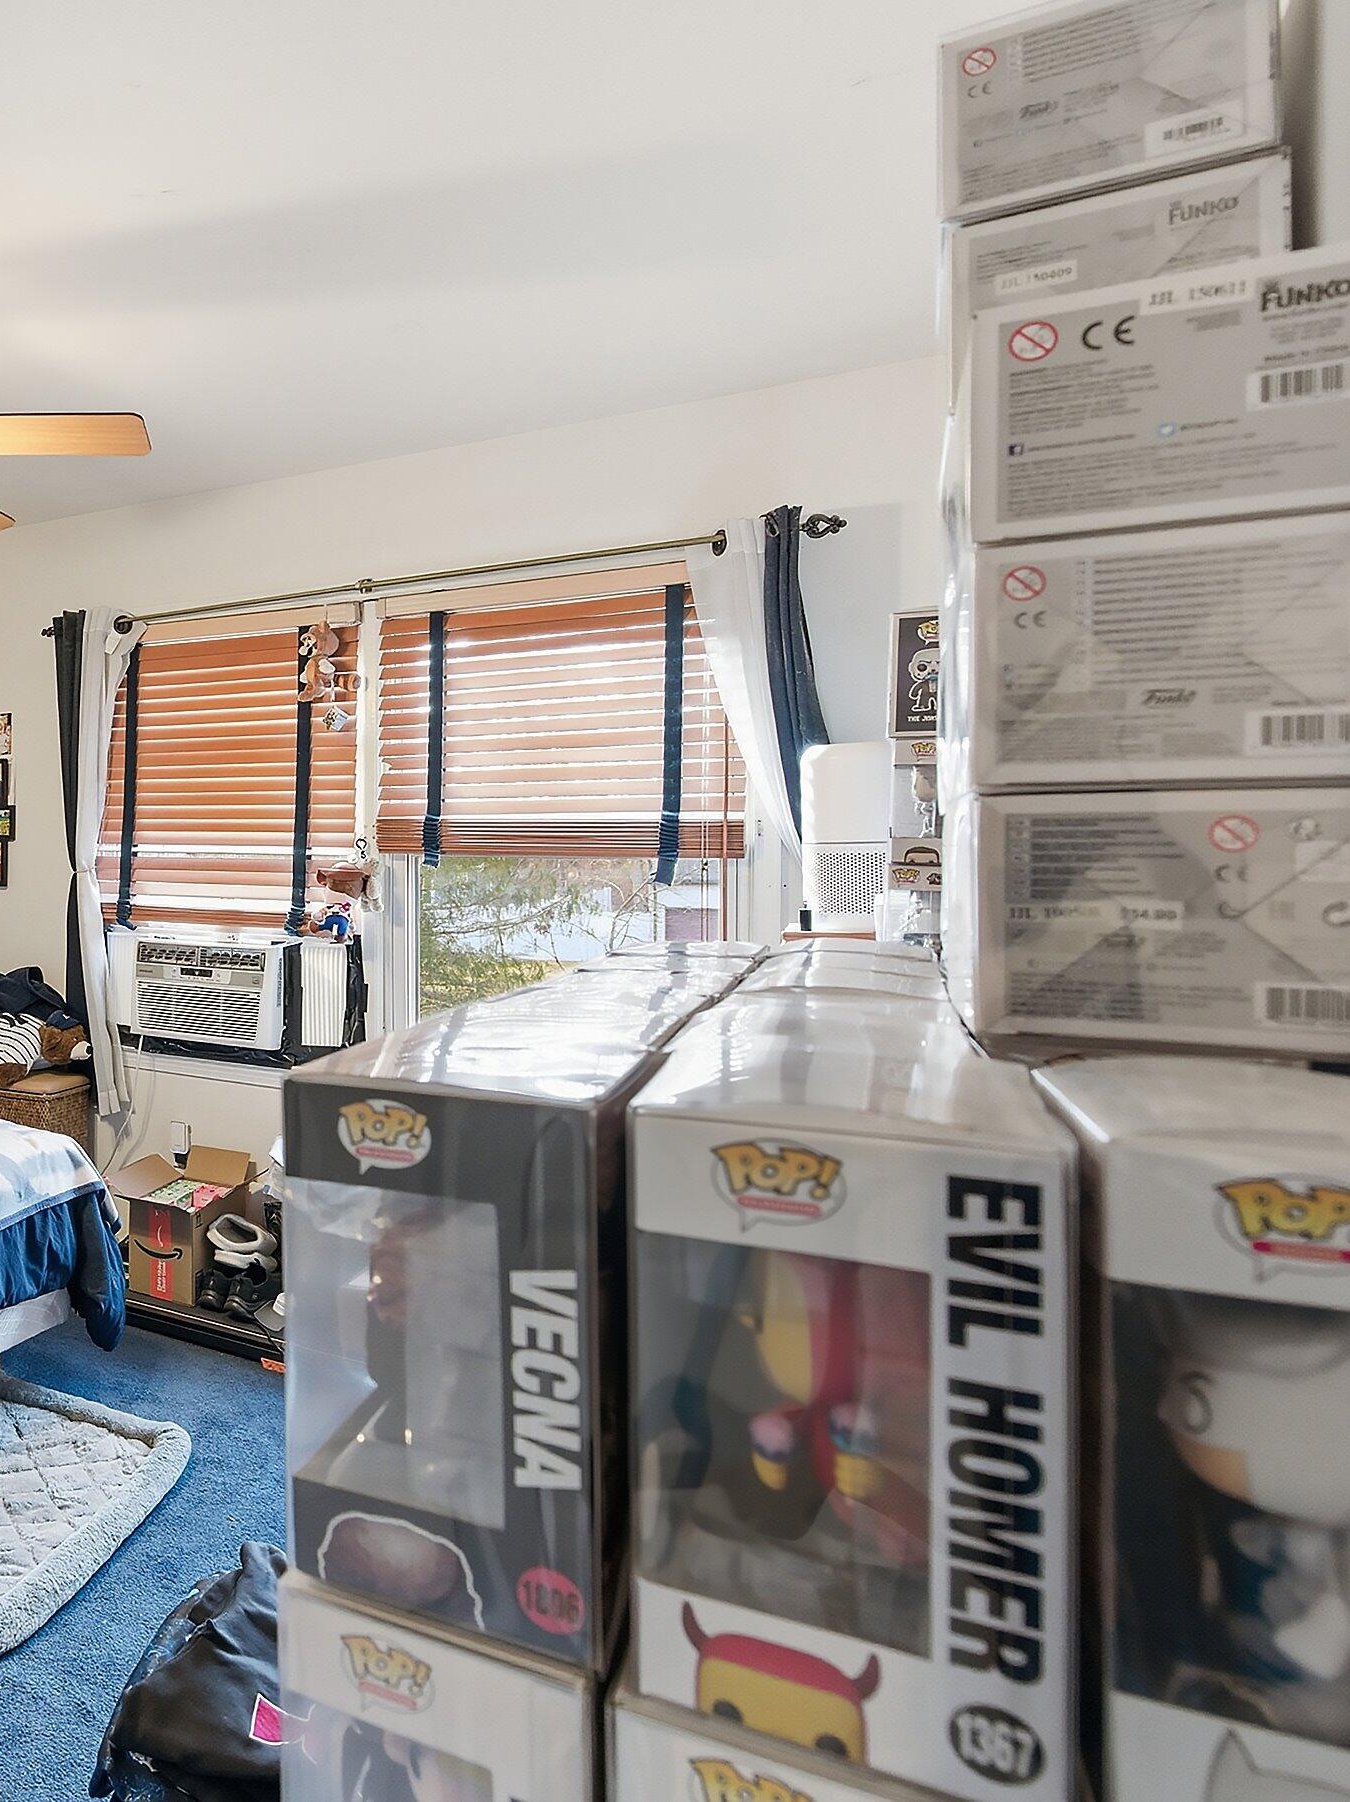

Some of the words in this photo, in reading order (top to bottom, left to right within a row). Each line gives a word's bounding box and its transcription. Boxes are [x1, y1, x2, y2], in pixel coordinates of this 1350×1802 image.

[1168, 196, 1239, 225] FUNKO
[1260, 279, 1350, 313] FUNKO
[710, 1142, 842, 1201] POP!
[1214, 1178, 1350, 1240] POP
[946, 1174, 1044, 1350] EVIL
[508, 1268, 583, 1491] VECNA
[946, 1377, 1044, 1686] HOMER
